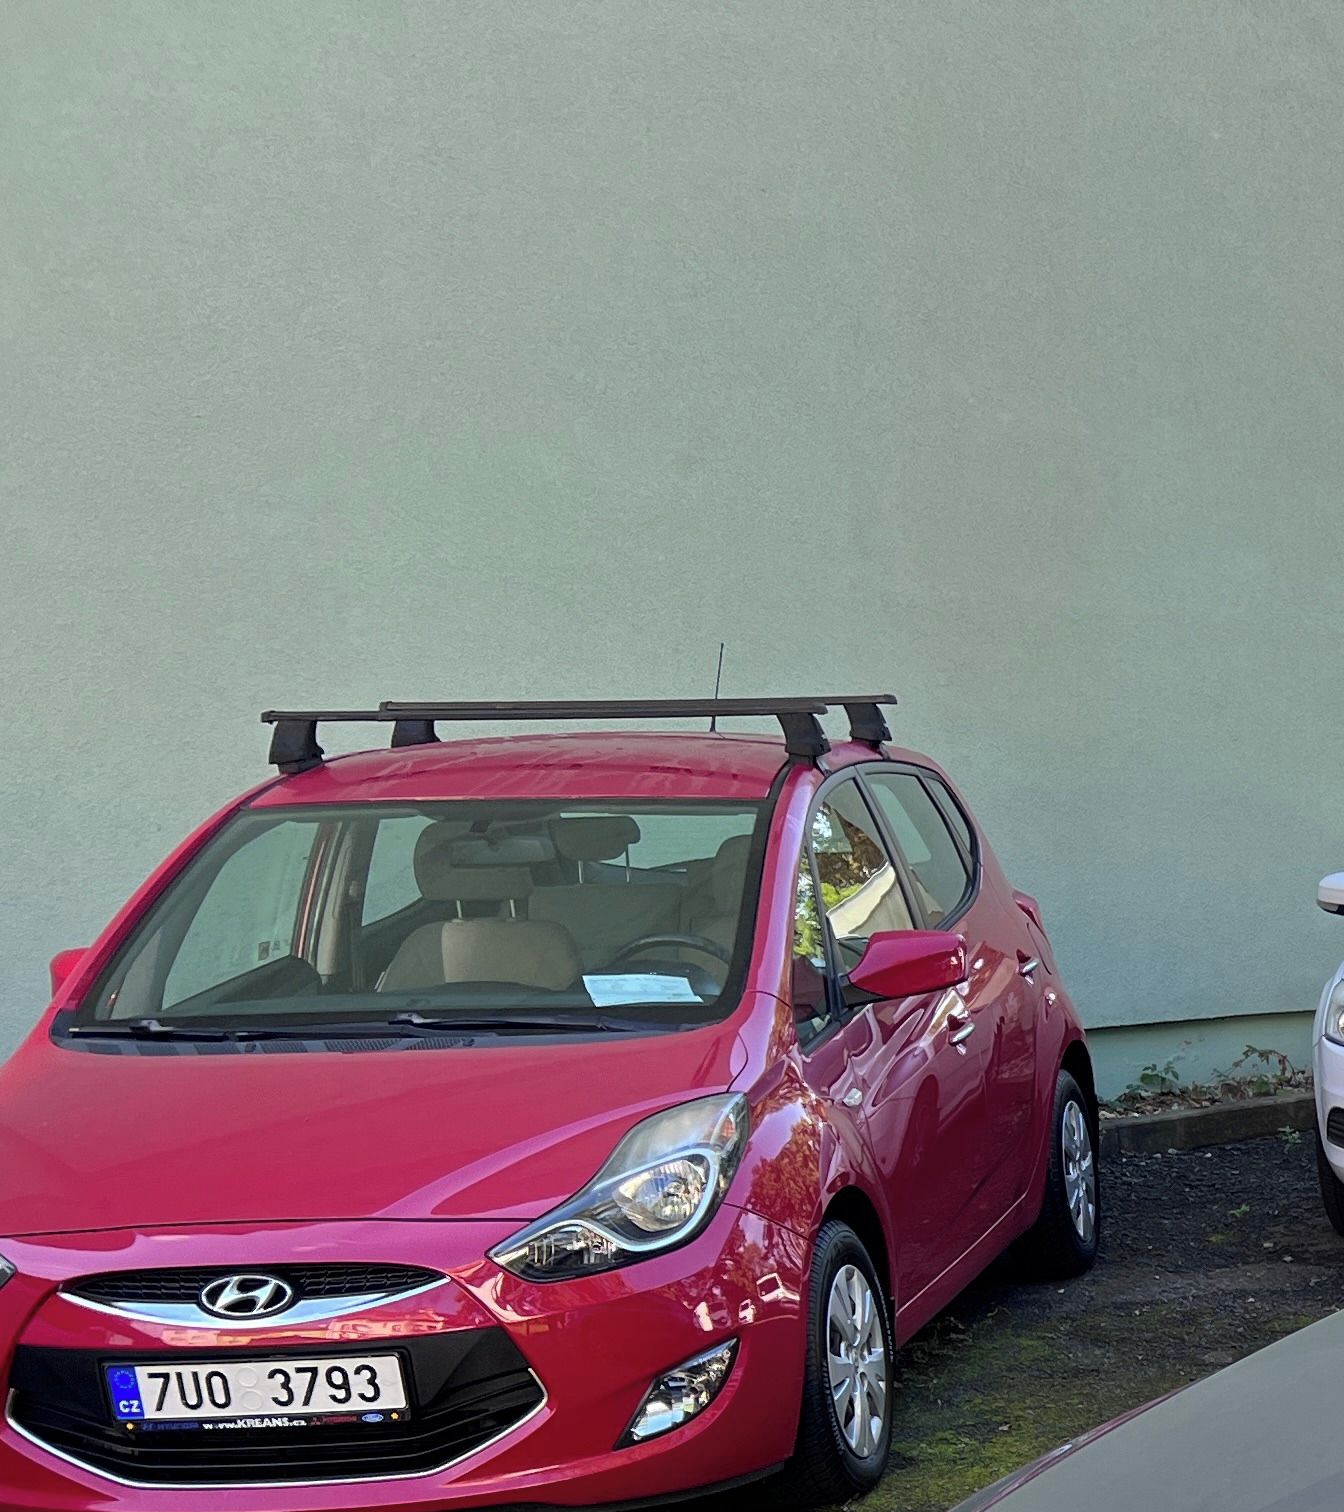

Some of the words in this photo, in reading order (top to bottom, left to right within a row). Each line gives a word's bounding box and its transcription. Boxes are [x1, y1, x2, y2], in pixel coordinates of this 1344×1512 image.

[119, 1400, 141, 1413] CZ
[147, 1370, 232, 1412] 7U0
[267, 1364, 381, 1408] 3793
